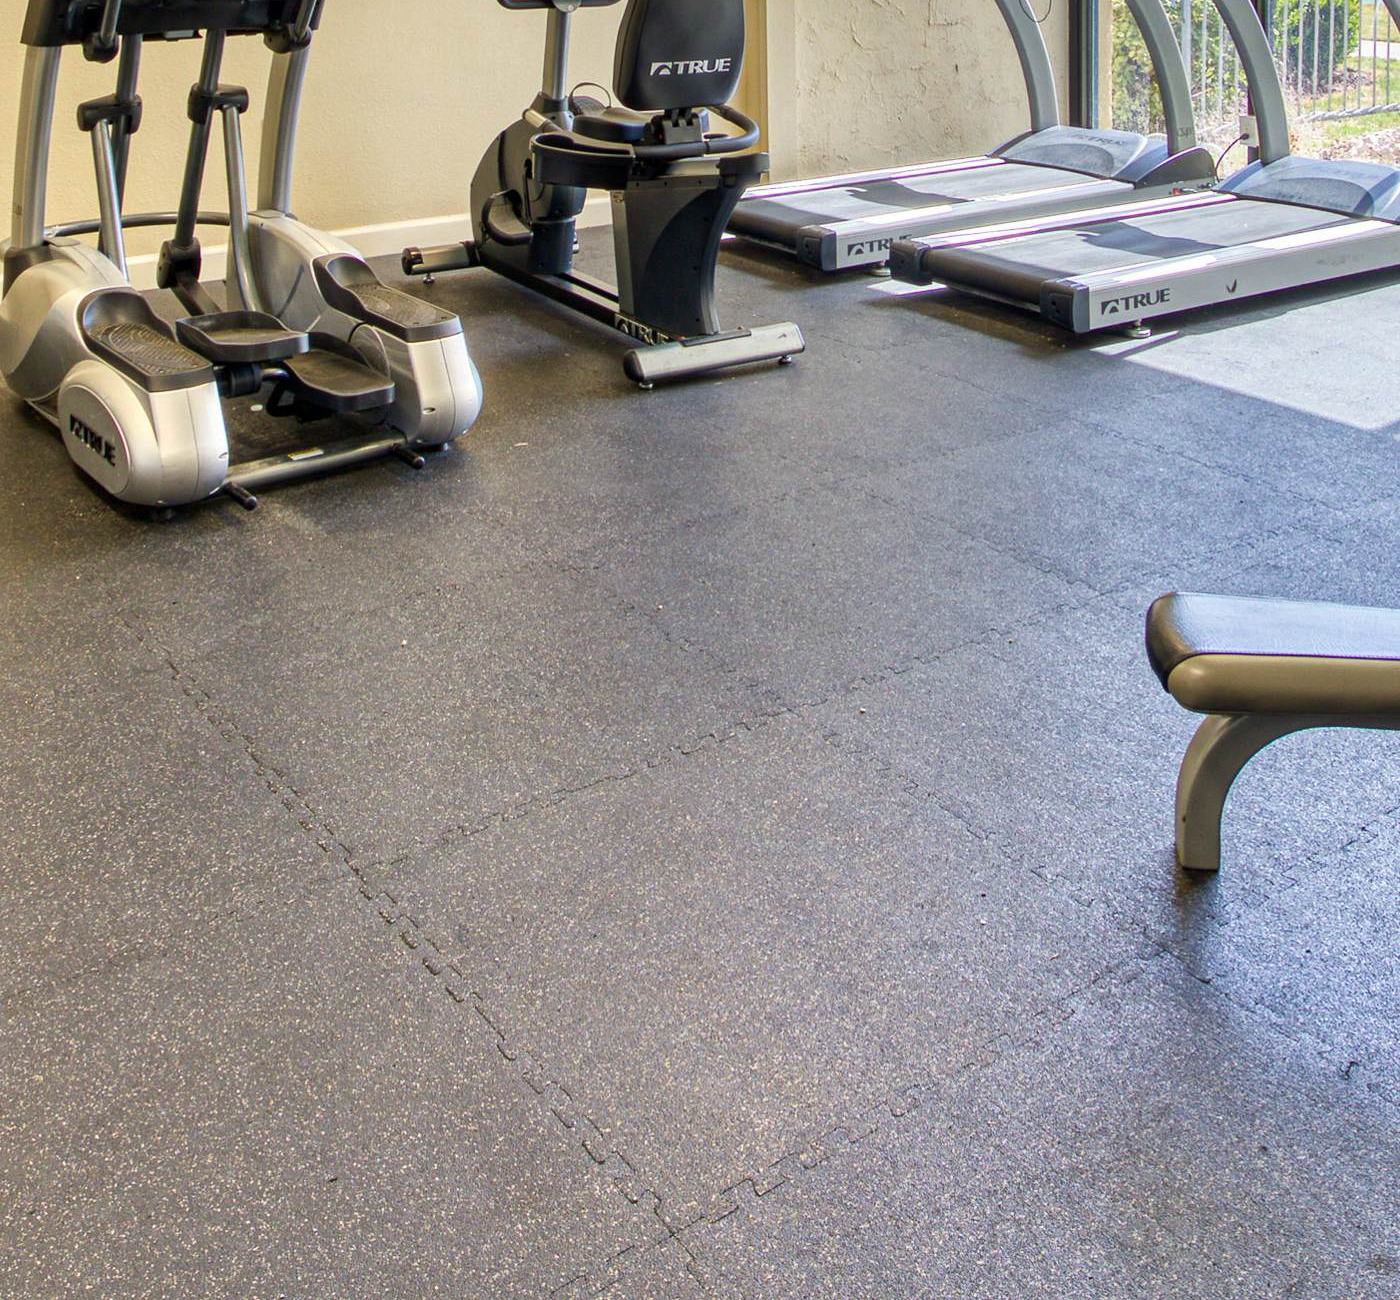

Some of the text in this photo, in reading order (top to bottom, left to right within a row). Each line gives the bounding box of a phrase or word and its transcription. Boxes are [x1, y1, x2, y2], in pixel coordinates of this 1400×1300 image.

[674, 58, 731, 75] TRUE
[865, 234, 912, 252] TR
[1119, 288, 1171, 311] TRUE
[80, 421, 116, 467] TRUE
